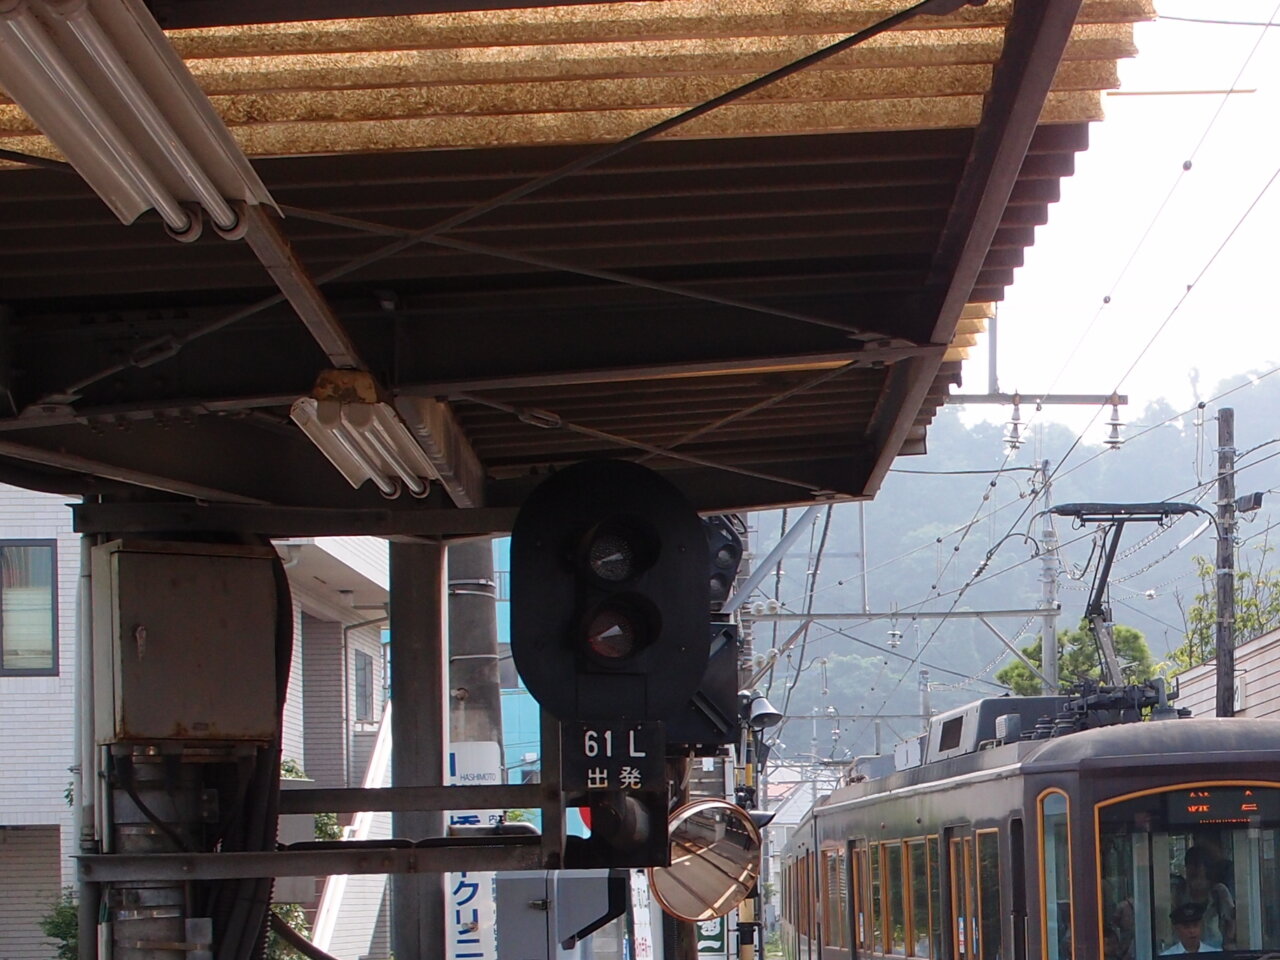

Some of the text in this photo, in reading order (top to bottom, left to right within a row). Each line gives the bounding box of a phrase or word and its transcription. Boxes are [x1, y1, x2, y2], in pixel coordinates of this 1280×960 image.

[584, 730, 646, 757] 61 L
[460, 773, 496, 781] HASHIMOTO
[587, 766, 642, 789] 出発
